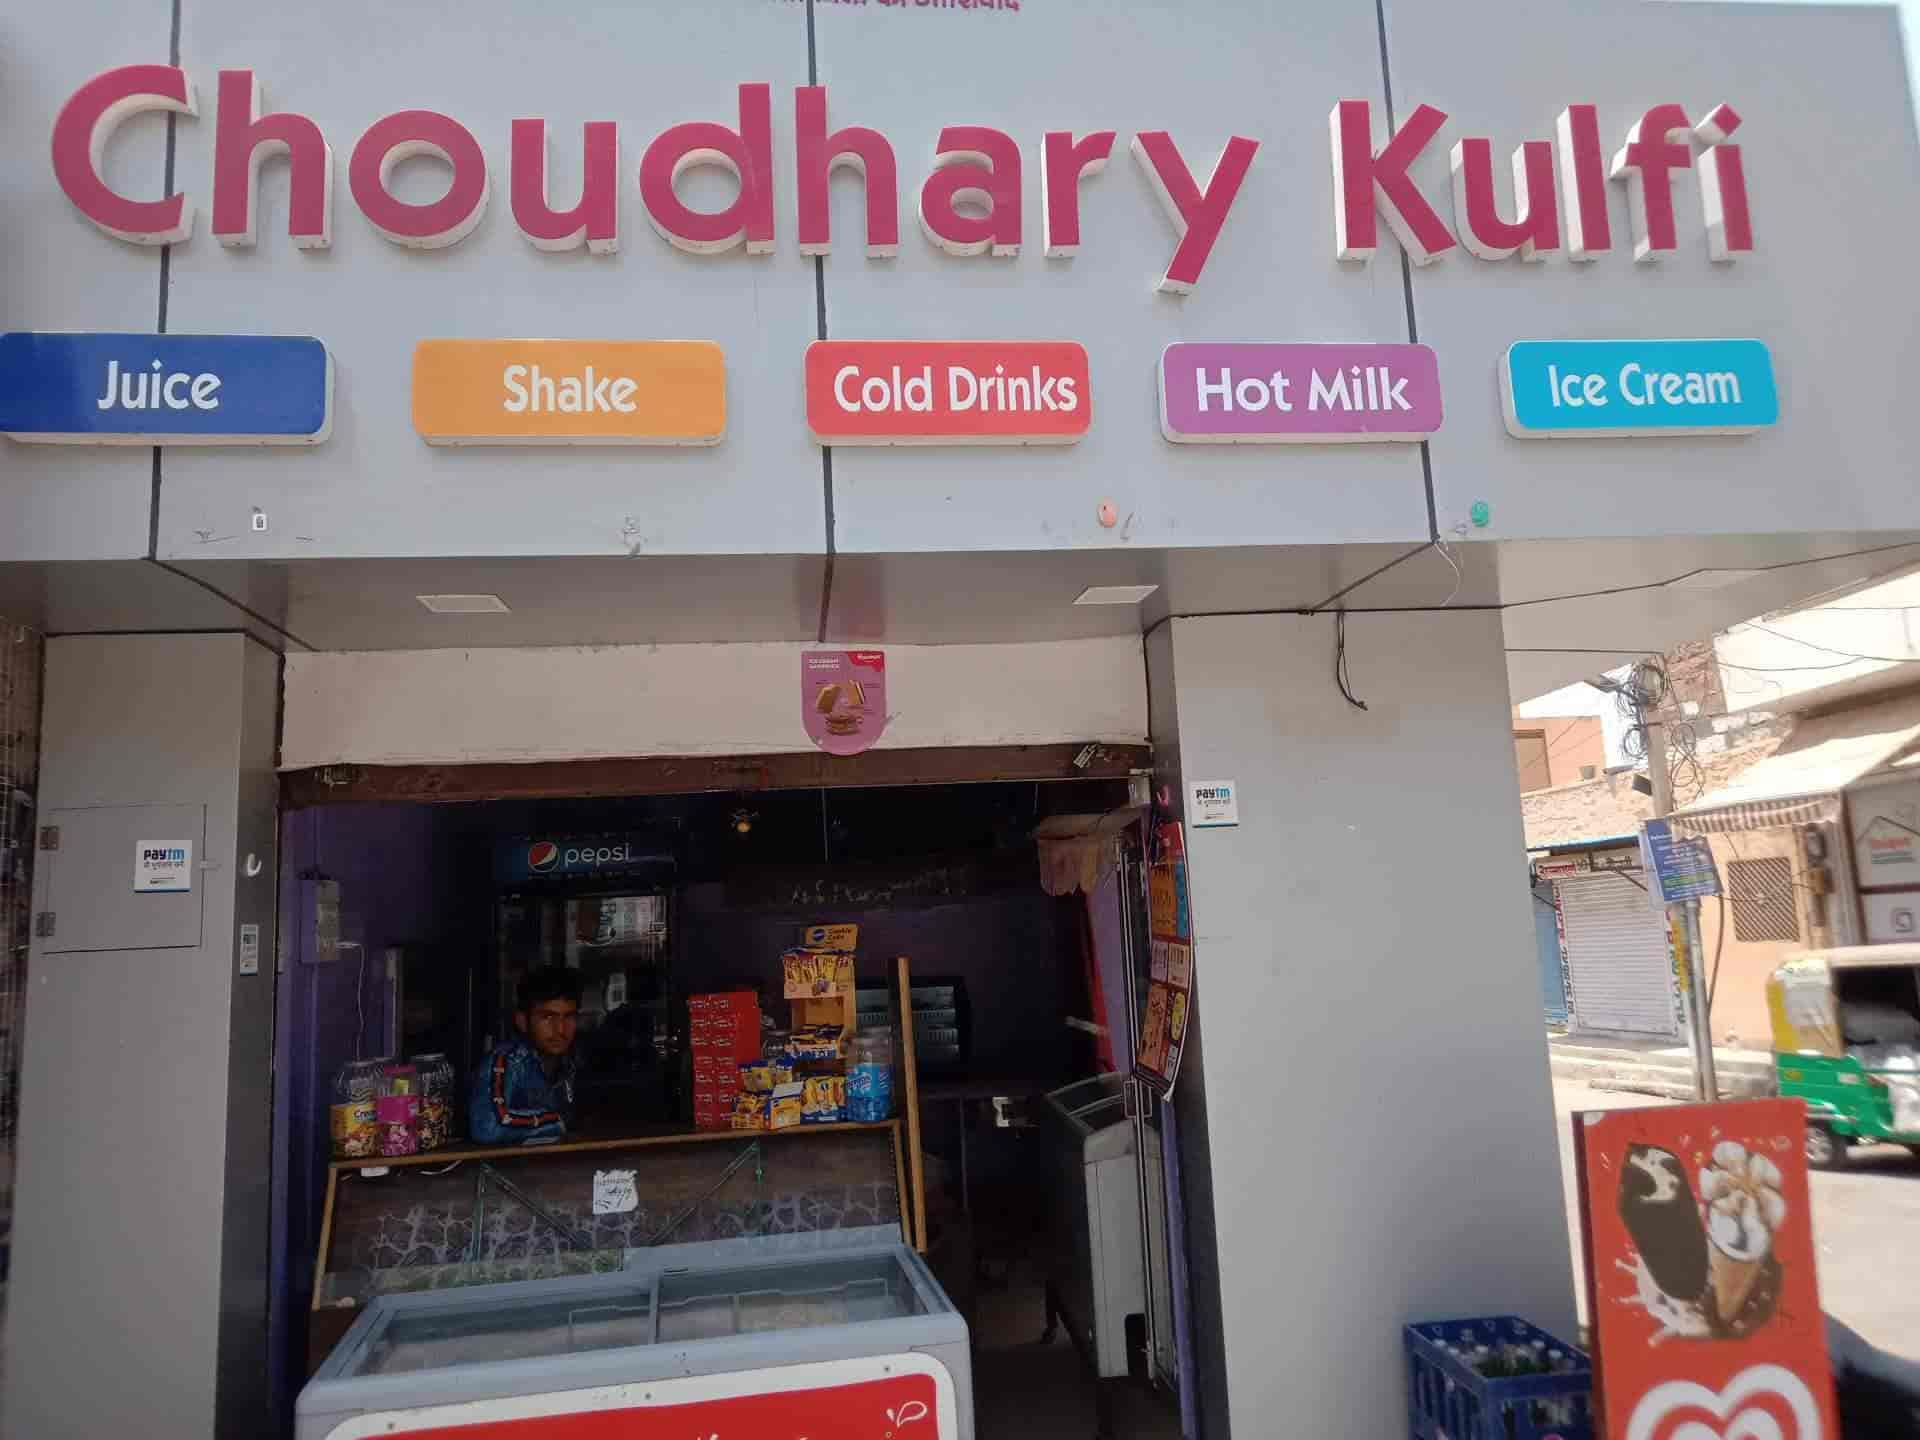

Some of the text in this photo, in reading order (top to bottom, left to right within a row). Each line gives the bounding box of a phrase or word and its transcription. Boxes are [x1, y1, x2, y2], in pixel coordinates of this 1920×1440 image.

[53, 64, 1754, 288] Choudhary Kulfi
[97, 359, 222, 411] Juice
[503, 364, 639, 414] Shake
[834, 365, 1079, 413] Cold Drinks
[1196, 366, 1413, 413] Hot Milk
[1549, 363, 1742, 407] Ice Cream
[563, 842, 631, 866] pepsi
